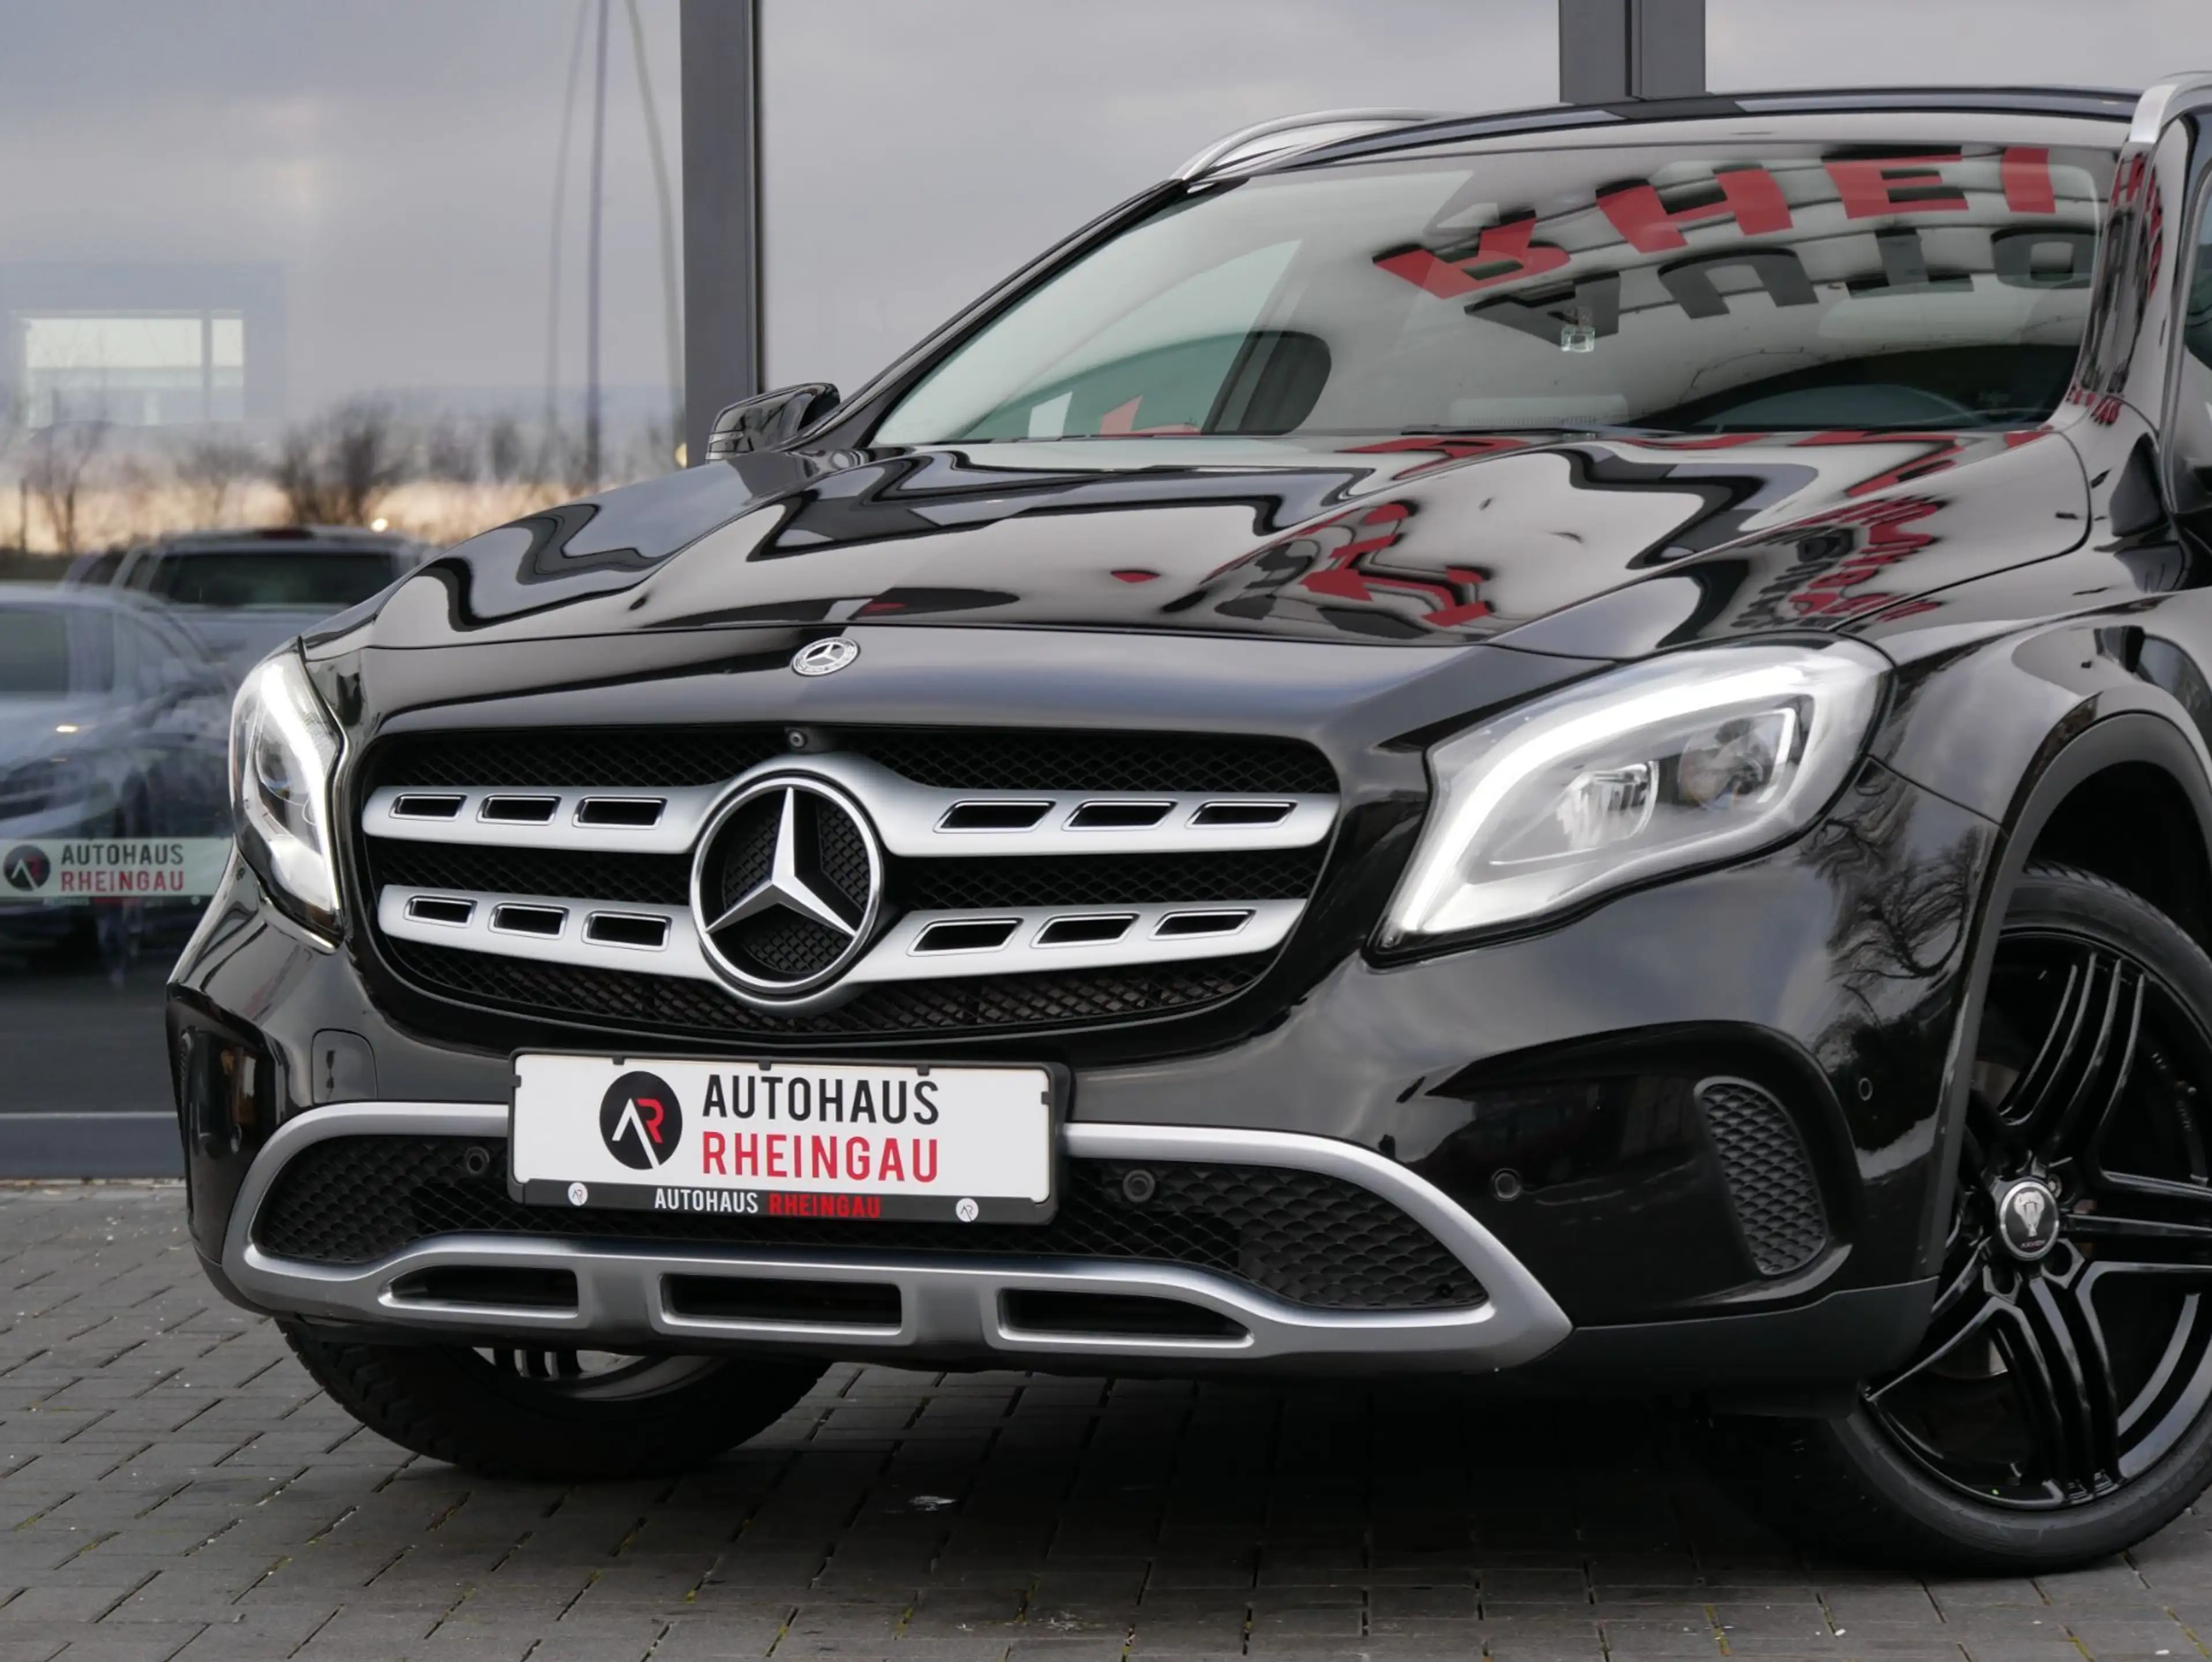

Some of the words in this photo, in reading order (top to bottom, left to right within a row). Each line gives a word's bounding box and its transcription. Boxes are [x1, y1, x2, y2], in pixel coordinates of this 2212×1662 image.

[61, 843, 184, 865] AUTOHAUS
[61, 870, 184, 892] RHEINGAU
[702, 1074, 939, 1125] AUTOHAUS
[703, 1131, 938, 1182] RHEINGAU
[654, 1186, 758, 1214] AUTOHAUS
[768, 1193, 882, 1219] RHEINGAU
